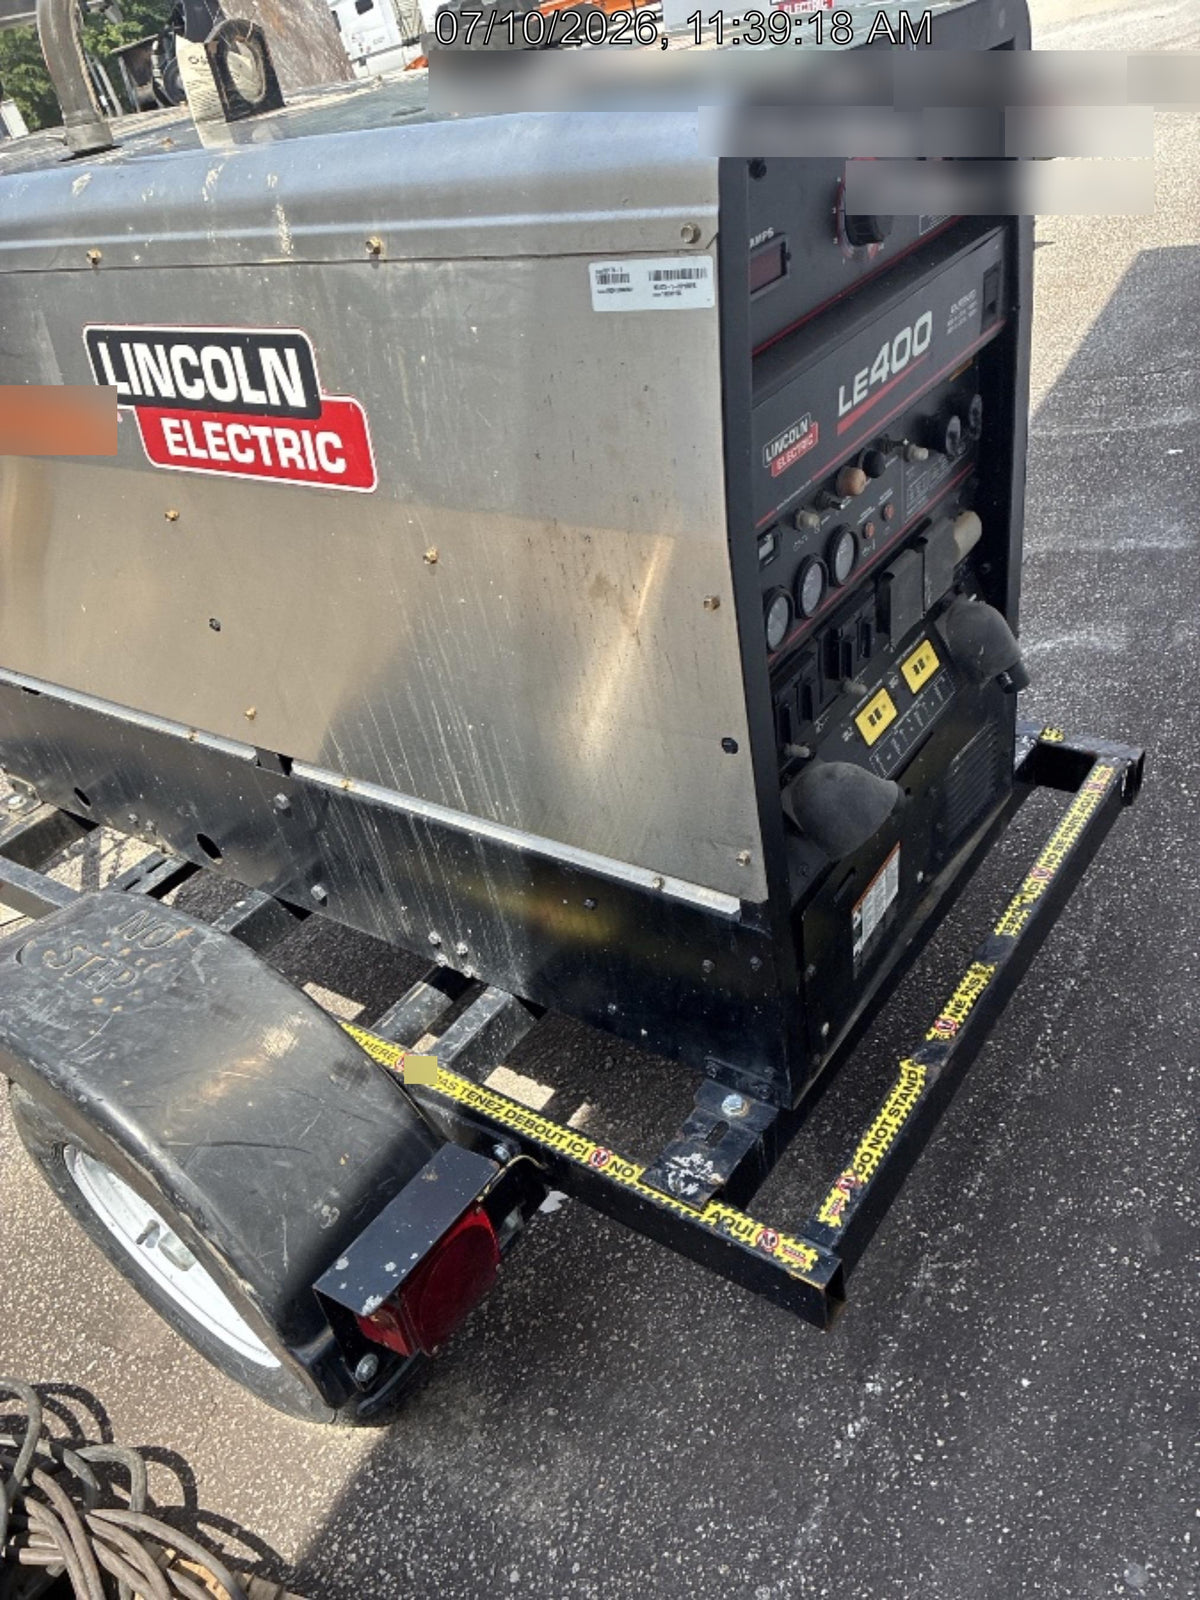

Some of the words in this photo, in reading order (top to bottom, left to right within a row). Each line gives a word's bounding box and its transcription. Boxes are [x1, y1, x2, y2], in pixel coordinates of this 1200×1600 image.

[97, 340, 307, 408] LINCOLN
[838, 311, 933, 416] LE400
[161, 417, 347, 475] ELECTRIC
[765, 418, 809, 461] LINCOLN
[111, 909, 178, 949] NO
[363, 1040, 399, 1062] HERE
[459, 1084, 501, 1114] TENEZ
[503, 1108, 565, 1145] DEBOUT
[567, 1139, 589, 1156] ICI
[856, 1151, 873, 1175] DO
[868, 1123, 888, 1151] NOT
[888, 1069, 919, 1117] STAND
[608, 1159, 636, 1178] NO
